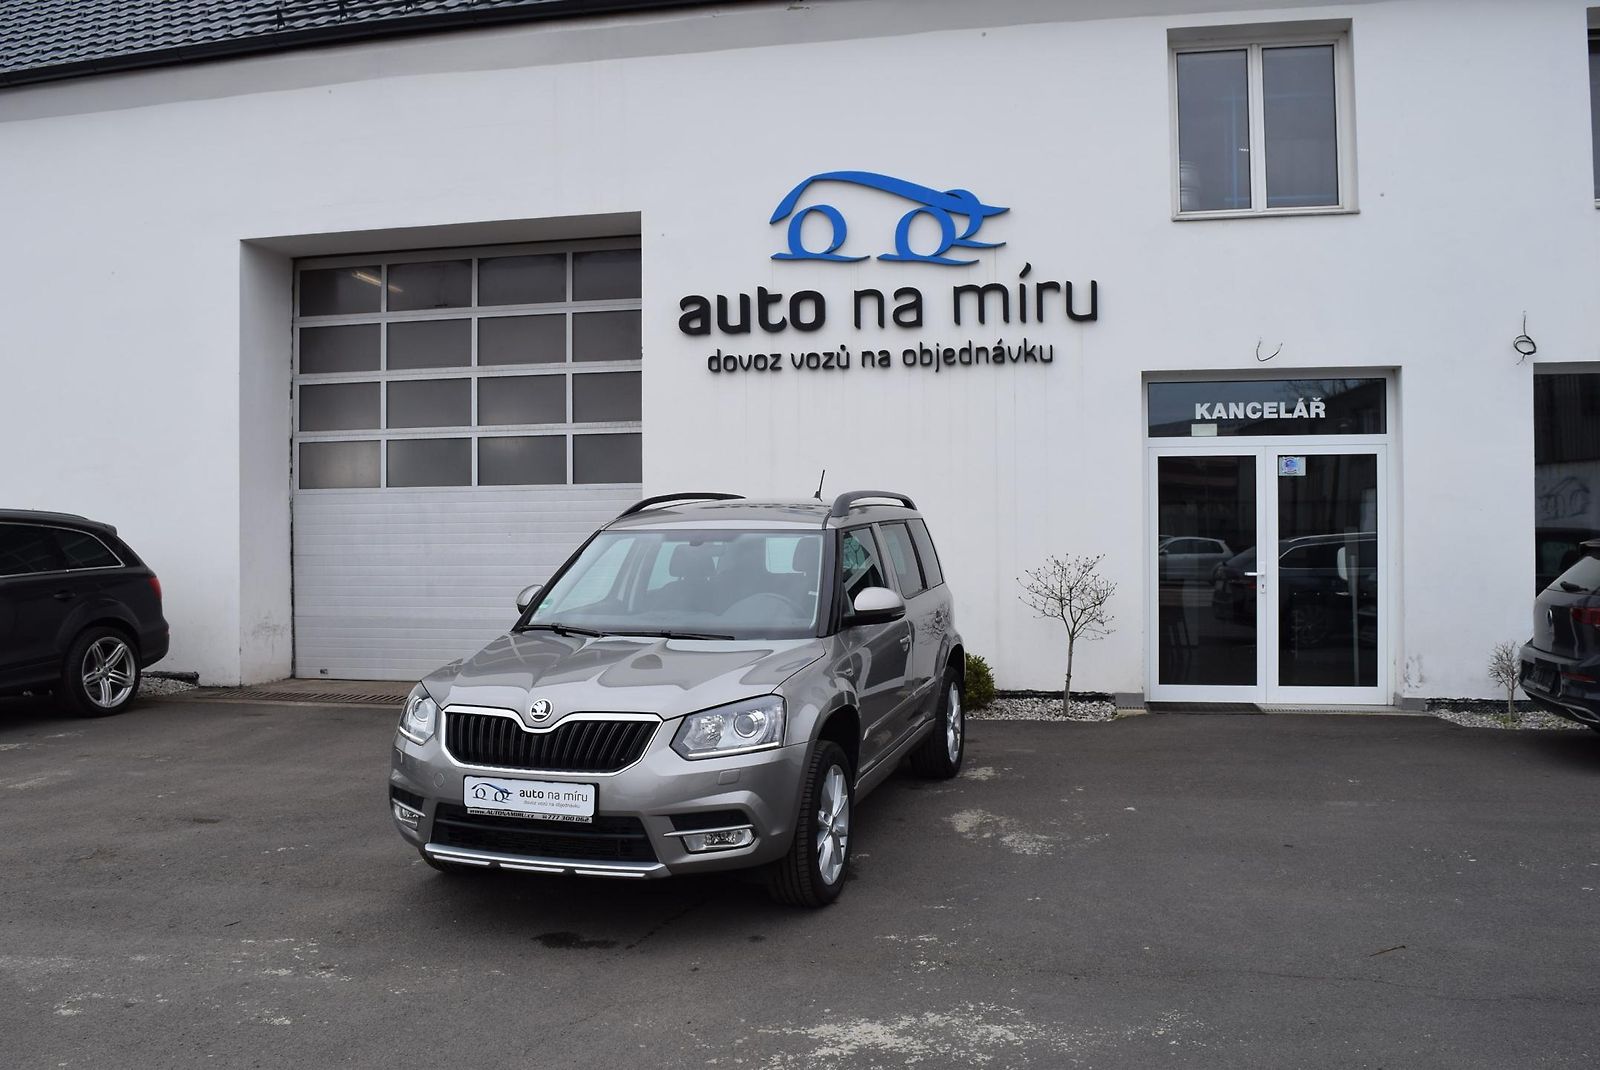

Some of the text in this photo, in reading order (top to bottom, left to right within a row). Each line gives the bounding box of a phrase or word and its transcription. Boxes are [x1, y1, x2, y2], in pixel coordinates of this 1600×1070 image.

[678, 262, 1099, 336] auto na míru
[707, 338, 1054, 373] dovoz vozů na objednávku
[1195, 397, 1326, 420] KANCELÁŘ
[519, 789, 588, 802] auto na míru
